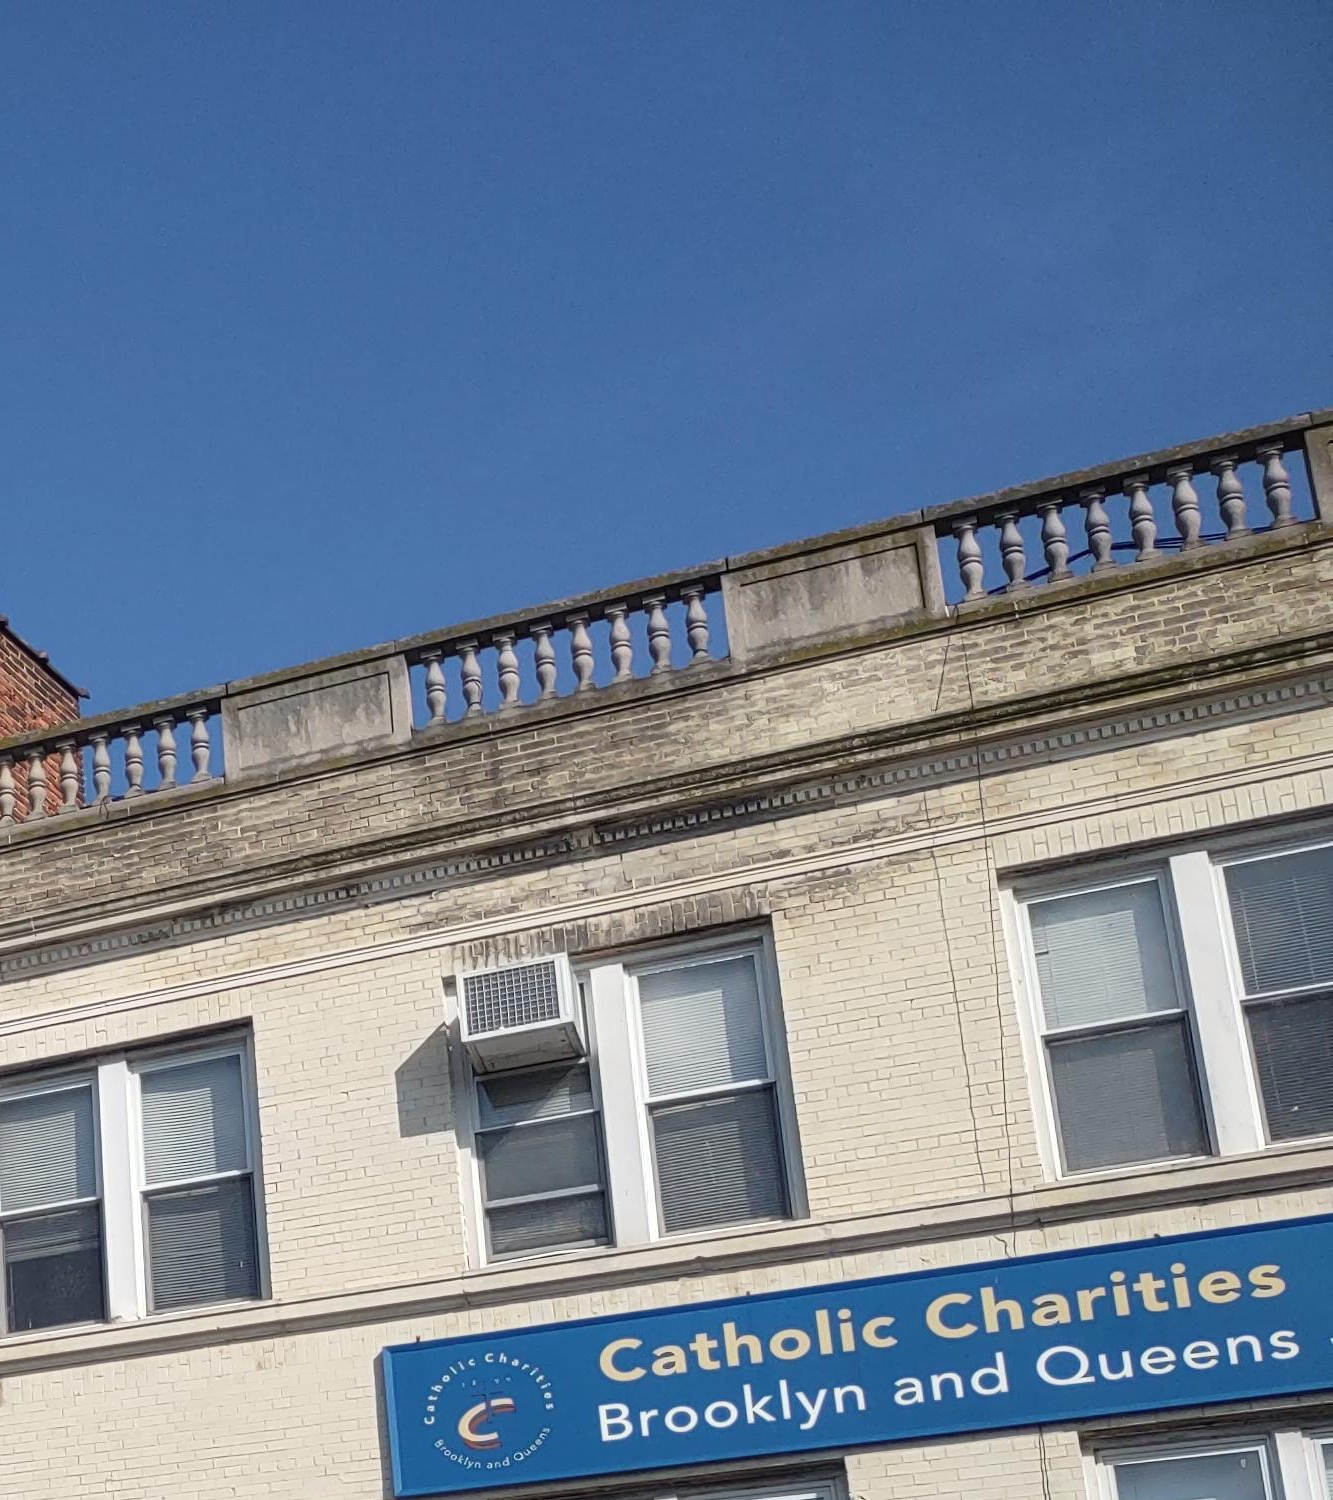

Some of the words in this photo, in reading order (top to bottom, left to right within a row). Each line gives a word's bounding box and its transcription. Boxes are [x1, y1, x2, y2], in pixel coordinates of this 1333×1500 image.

[599, 1308, 897, 1384] Catholic
[925, 1259, 1288, 1341] Charities
[424, 1358, 476, 1425] Catholic
[484, 1352, 554, 1410] Charities
[598, 1376, 867, 1444] Brooklyn
[893, 1353, 1010, 1407] and
[1035, 1327, 1301, 1390] Queens
[434, 1438, 482, 1470] Brooklyn
[486, 1456, 511, 1469] and
[513, 1427, 551, 1461] Queens
